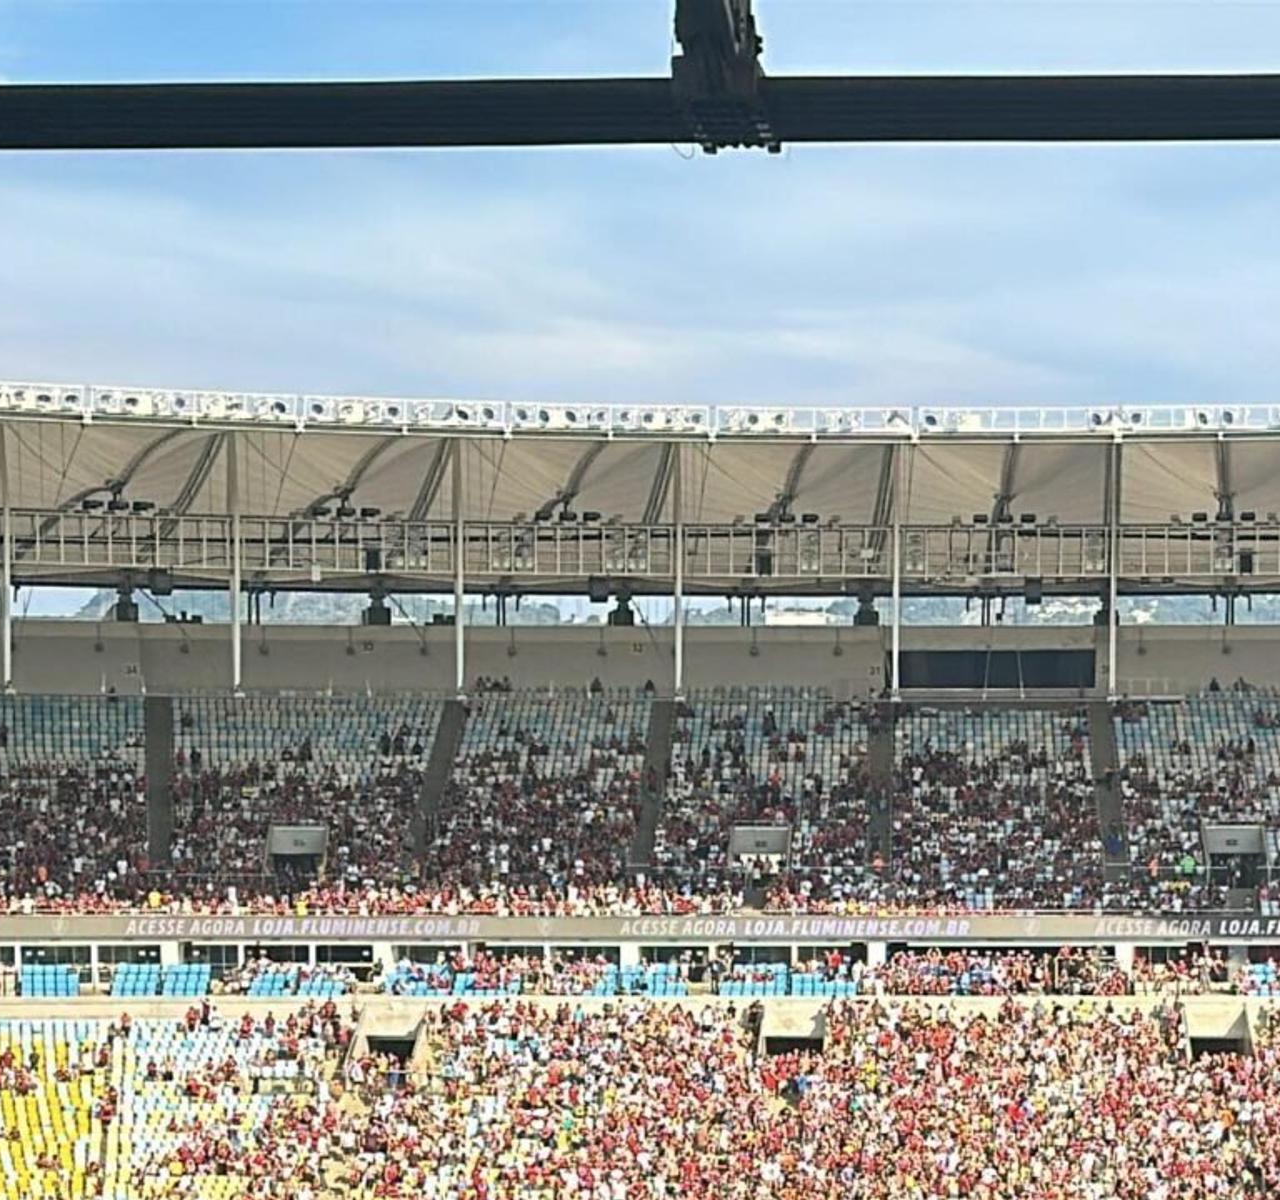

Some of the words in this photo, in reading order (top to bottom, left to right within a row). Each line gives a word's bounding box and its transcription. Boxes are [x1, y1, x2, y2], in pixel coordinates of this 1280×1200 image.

[126, 920, 185, 936] ACESSE
[188, 920, 245, 936] AGORA
[252, 919, 479, 936] LOJA.FLUMINENSE.COM.BR
[619, 920, 678, 936] ACESSE
[681, 920, 736, 936] AGORA
[743, 919, 970, 936] LOJA.FLUMINENSE.COM.BR
[1093, 920, 1153, 935] ACESSE
[1155, 919, 1212, 935] AGORA
